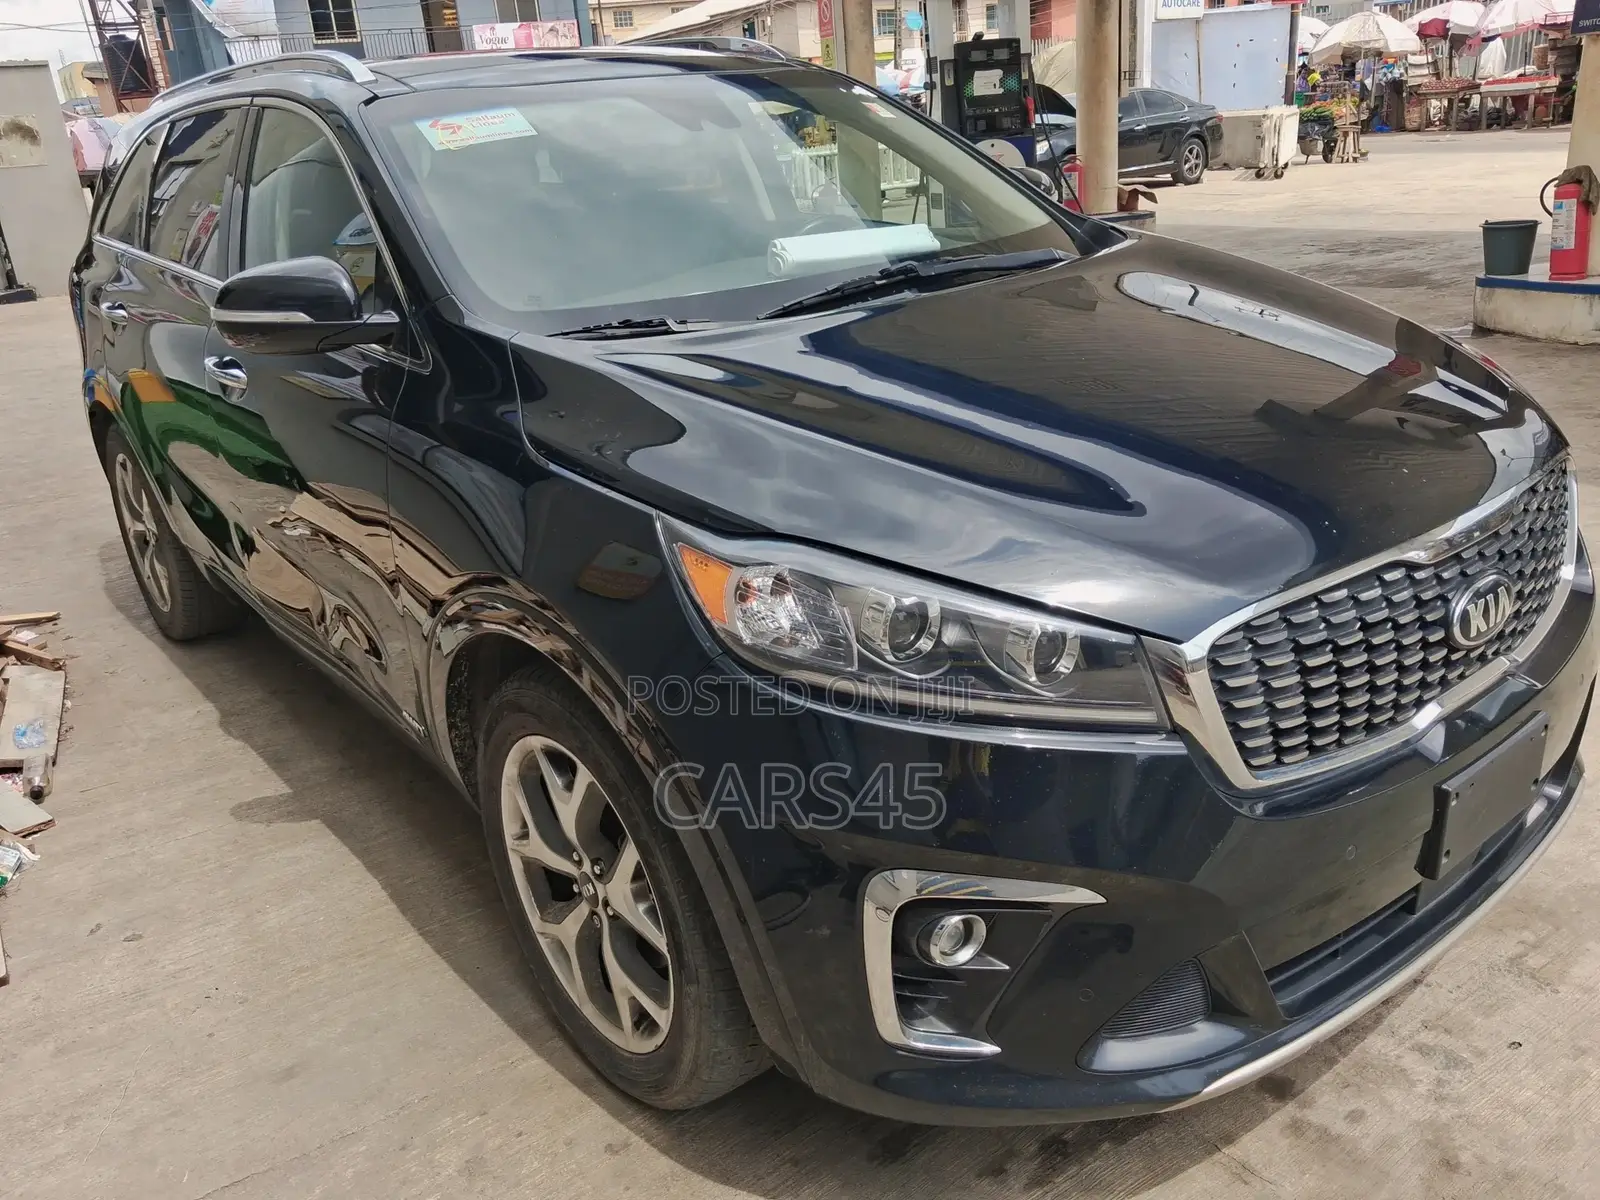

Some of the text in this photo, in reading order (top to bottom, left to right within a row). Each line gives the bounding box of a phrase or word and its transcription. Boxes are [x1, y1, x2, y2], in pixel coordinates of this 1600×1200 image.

[1161, 0, 1201, 8] AUTOCARE
[479, 35, 509, 47] Vogue
[1466, 586, 1511, 638] KIA
